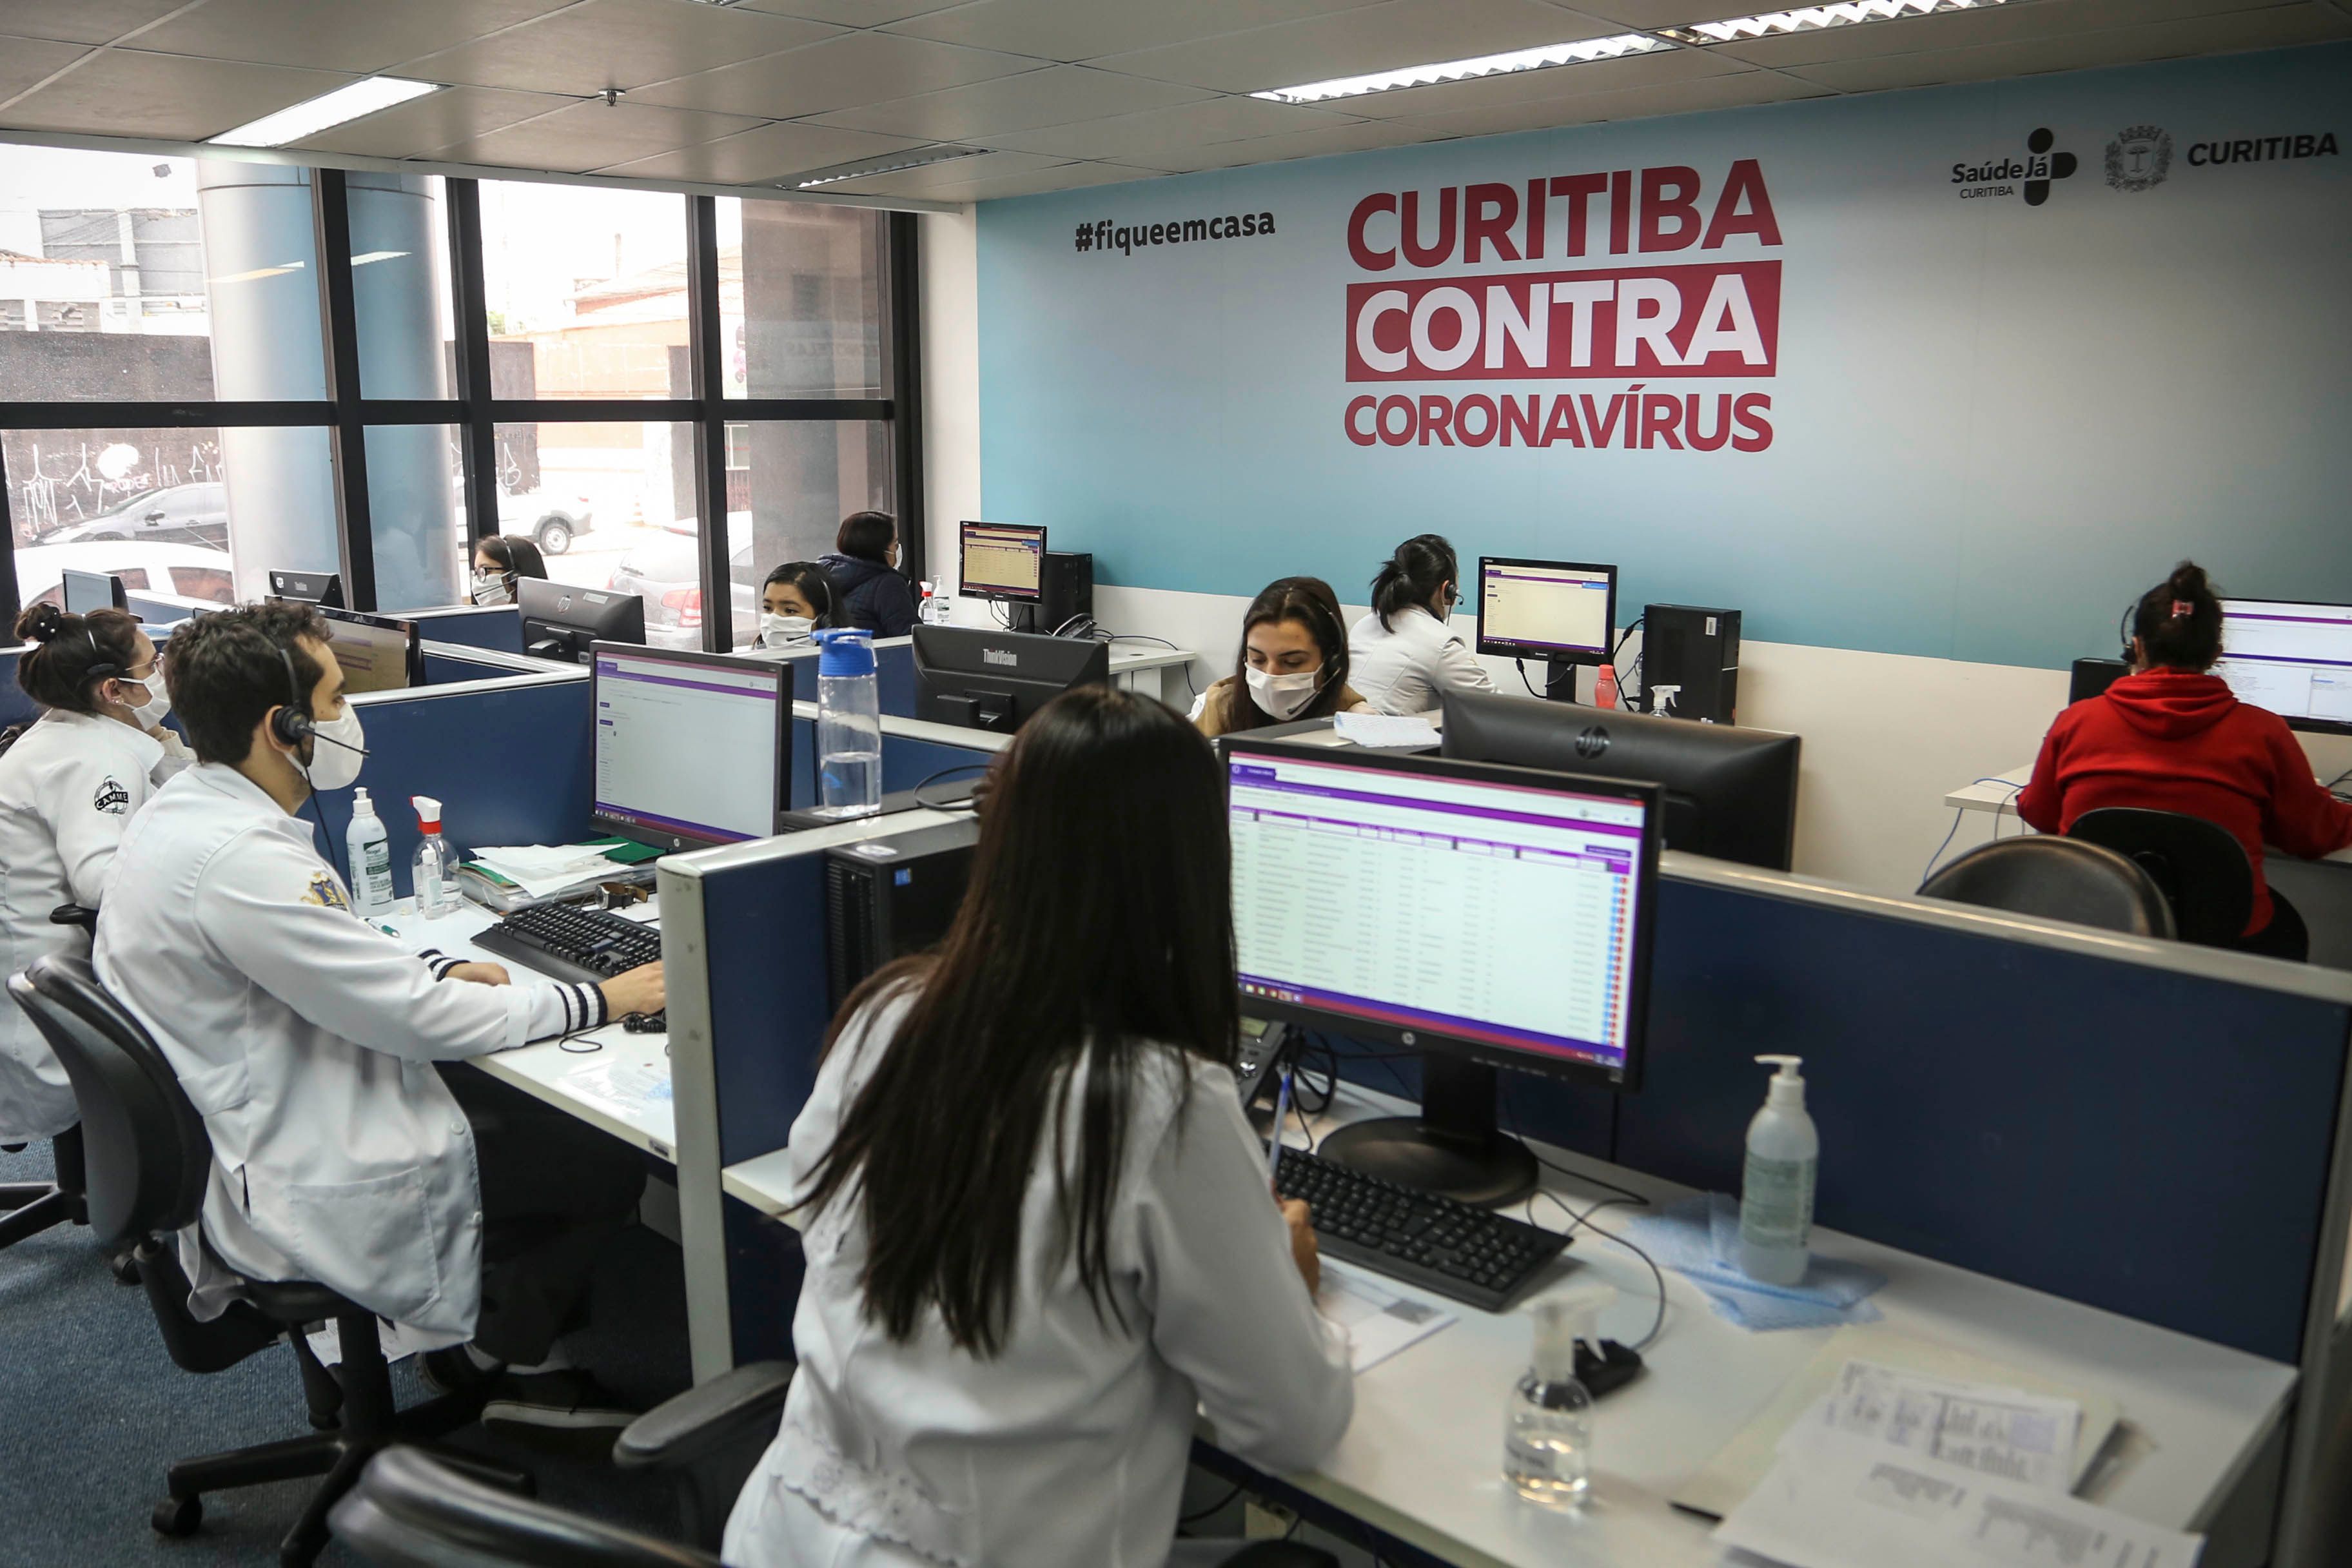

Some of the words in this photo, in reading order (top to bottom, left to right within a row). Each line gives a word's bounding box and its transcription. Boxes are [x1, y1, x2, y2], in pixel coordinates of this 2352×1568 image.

[2187, 132, 2338, 166] CURITIBA
[1347, 160, 1782, 272] CURITIBA
[1960, 185, 2014, 199] CURITIBA
[1075, 211, 1276, 256] #fiqueemcasa
[1355, 273, 1768, 373] CONTRA
[1345, 385, 1774, 452] CORONAVÍRUS
